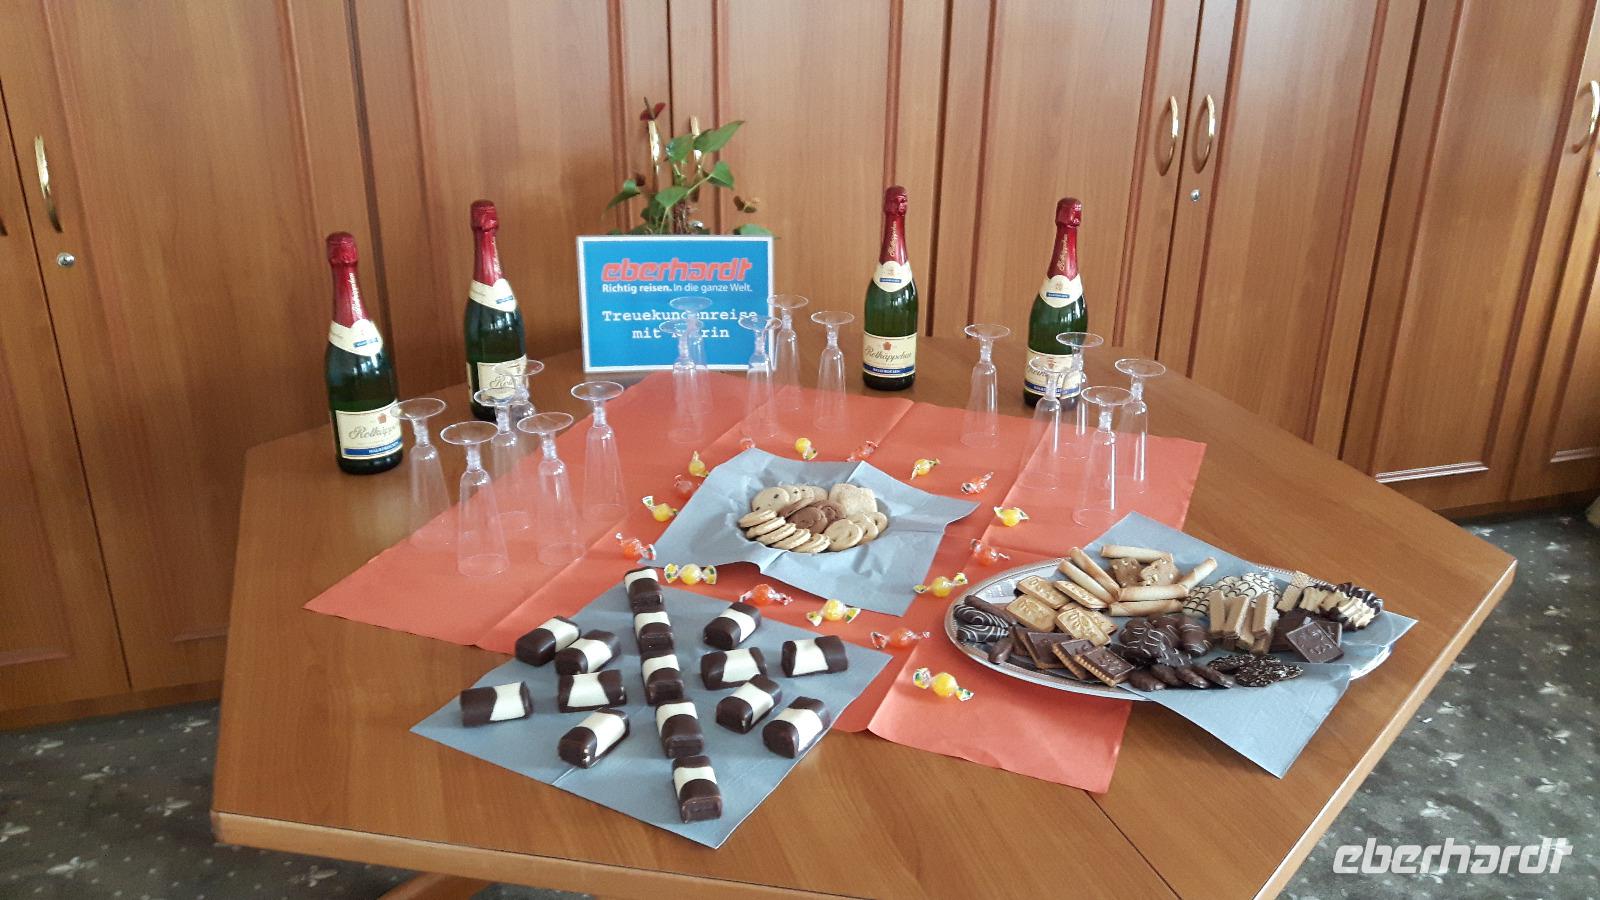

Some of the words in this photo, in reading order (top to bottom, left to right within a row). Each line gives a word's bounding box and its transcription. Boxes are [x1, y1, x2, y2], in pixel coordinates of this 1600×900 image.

[601, 257, 752, 282] eberhardt
[602, 283, 637, 294] Richtig
[639, 284, 673, 293] reisen.
[673, 283, 682, 292] In
[684, 283, 699, 292] die
[701, 284, 729, 294] ganze
[730, 283, 753, 292] Welt.
[632, 327, 661, 339] mit
